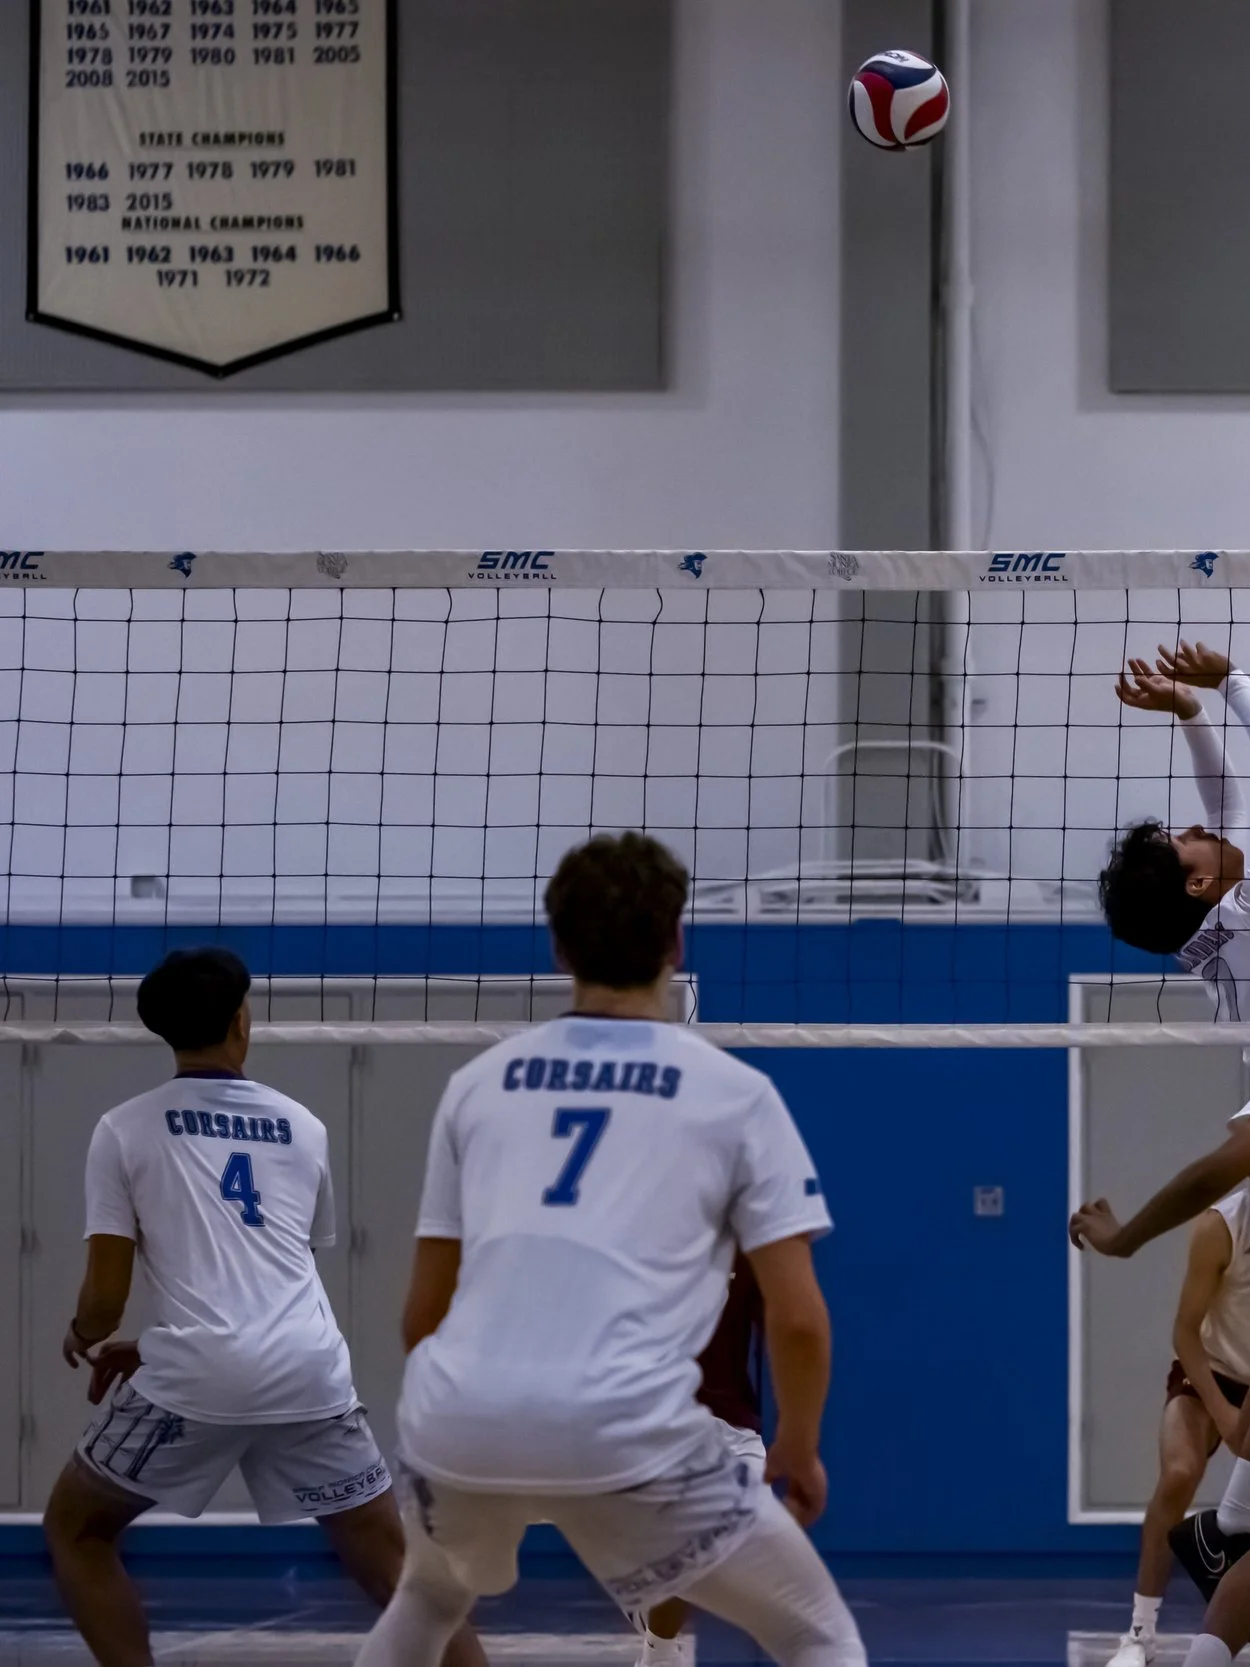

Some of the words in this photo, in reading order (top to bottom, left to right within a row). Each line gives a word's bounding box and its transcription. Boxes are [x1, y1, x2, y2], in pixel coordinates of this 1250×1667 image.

[68, 0, 110, 15] 1961
[128, 0, 172, 15] 1962
[190, 0, 234, 15] 1963
[252, 0, 297, 15] 1964
[315, 0, 359, 15] 1965
[128, 22, 172, 40] 1967
[190, 22, 235, 40] 1974
[252, 21, 298, 40] 1975
[315, 20, 359, 39] 1977
[67, 46, 113, 65] 1978
[128, 46, 172, 64] 1979
[190, 46, 235, 65] 1980
[253, 46, 295, 65] 1981
[313, 44, 361, 64] 2005
[65, 69, 113, 88] 2008
[126, 69, 171, 88] 2015
[139, 131, 183, 146] STATE
[191, 130, 285, 146] CHAMPIONS
[66, 162, 109, 180] 1966
[128, 162, 173, 180] 1977
[187, 161, 233, 179] 1978
[250, 159, 295, 178] 1979
[314, 158, 356, 178] 1981
[67, 193, 110, 212] 1983
[126, 192, 172, 211] 2015
[122, 215, 201, 231] NATIONAL
[209, 214, 303, 230] CHAMPIONS
[65, 246, 109, 264] 1961
[127, 246, 171, 264] 1962
[189, 246, 234, 263] 1963
[251, 245, 297, 263] 1964
[314, 244, 361, 263] 1966
[156, 269, 199, 287] 1971
[225, 268, 270, 287] 1972
[0, 551, 45, 570] MC
[476, 551, 555, 569] SMC
[988, 553, 1066, 572] SMC
[503, 1057, 682, 1099] CORSAIRS
[165, 1109, 292, 1145] CORSAIRS
[541, 1107, 613, 1207] 7
[220, 1152, 265, 1227] 4
